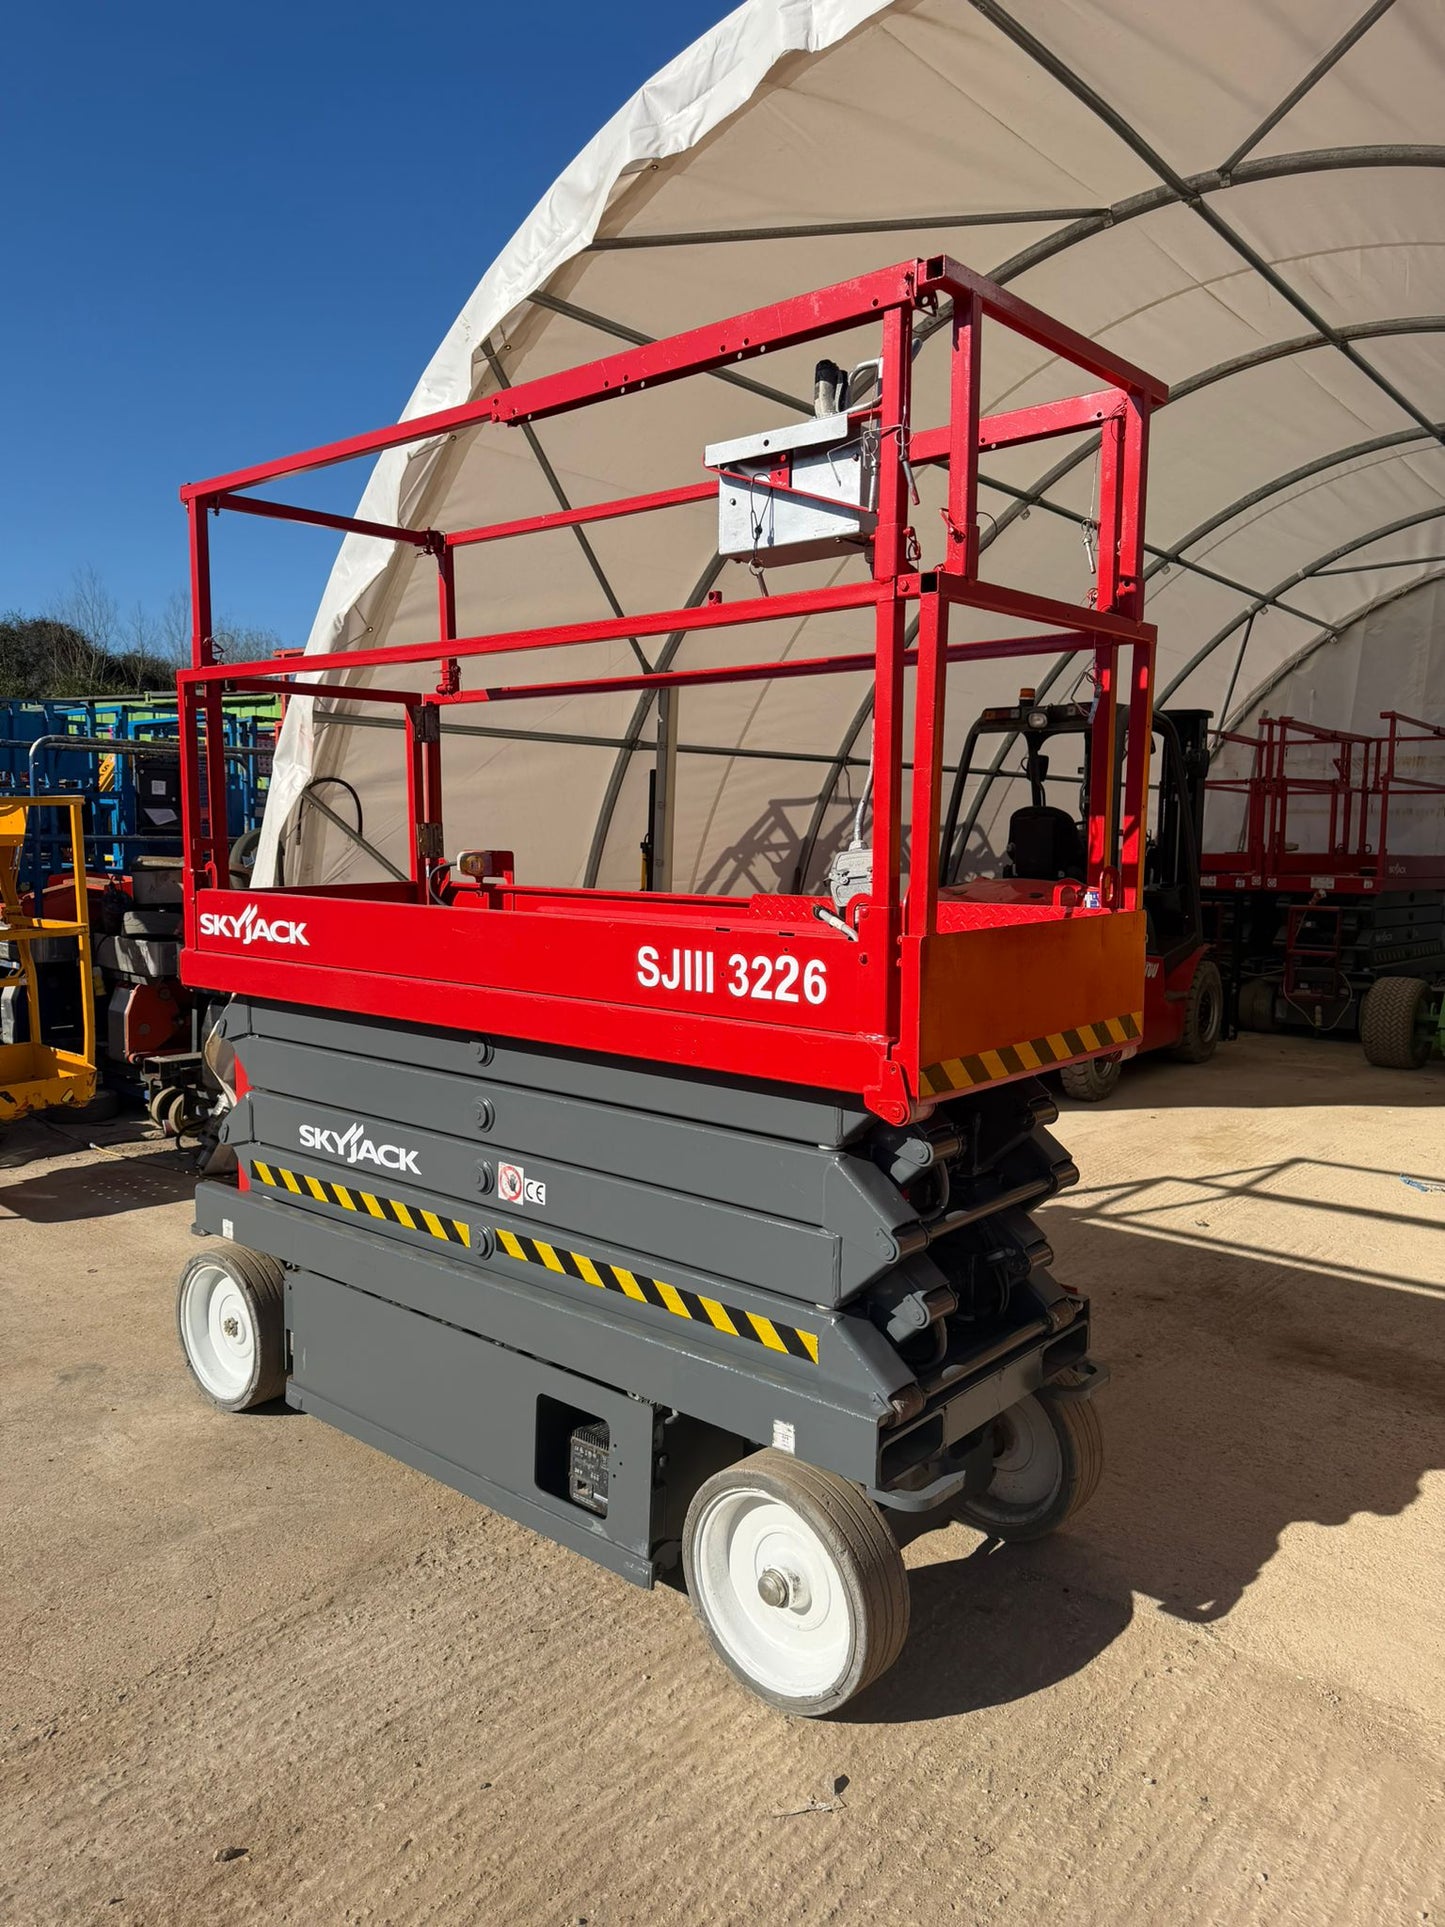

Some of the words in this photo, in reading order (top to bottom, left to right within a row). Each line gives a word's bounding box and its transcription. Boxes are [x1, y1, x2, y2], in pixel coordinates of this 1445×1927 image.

[200, 903, 310, 946] SKYJACK
[637, 945, 714, 994] SJIII
[728, 953, 827, 1005] 3226
[299, 1122, 422, 1175] SKYJACK
[525, 1181, 544, 1203] CE
